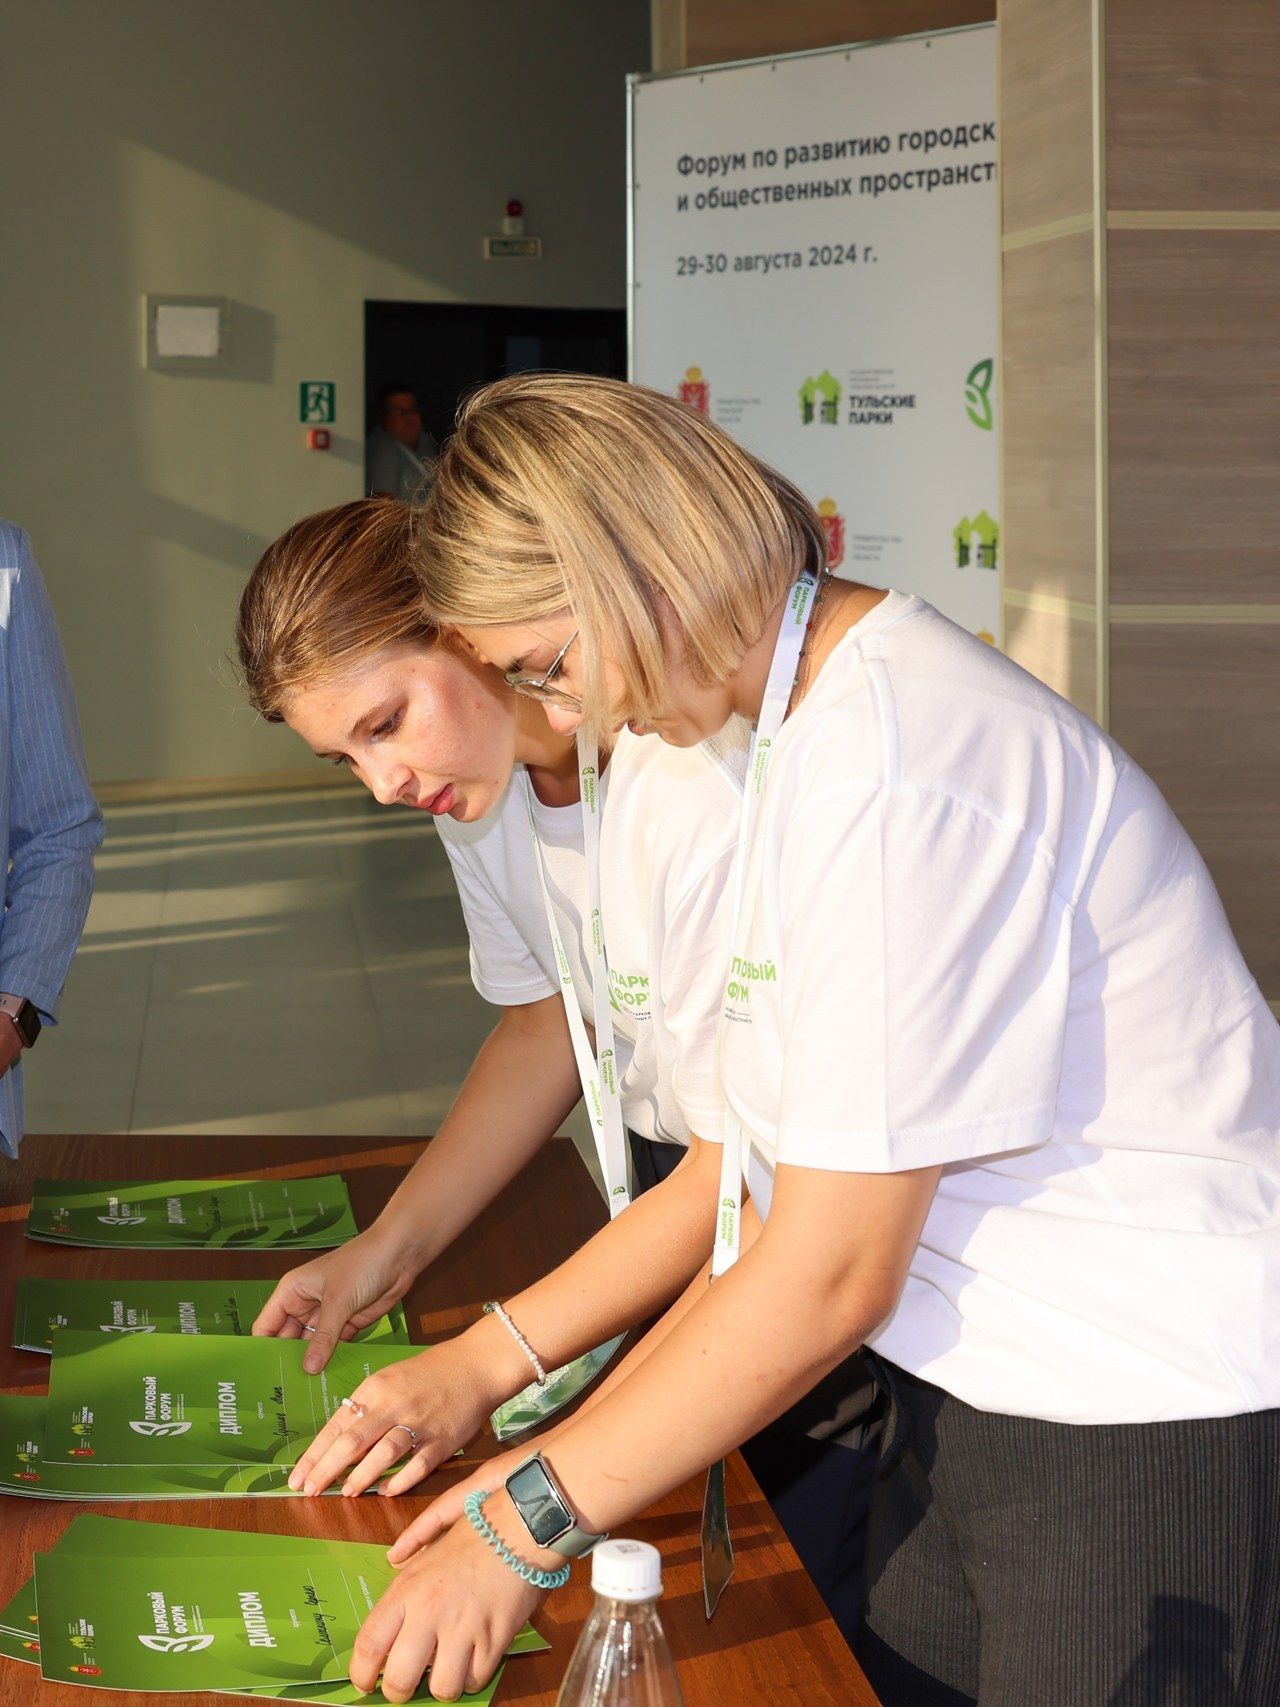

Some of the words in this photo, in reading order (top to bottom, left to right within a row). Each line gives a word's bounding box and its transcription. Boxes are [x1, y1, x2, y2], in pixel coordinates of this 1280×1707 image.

[677, 153, 746, 177] Форум
[753, 148, 778, 168] по
[785, 135, 891, 169] развитию
[898, 120, 996, 154] городск
[677, 196, 689, 212] и
[695, 176, 853, 212] общественных
[859, 161, 999, 196] пространст
[676, 254, 728, 276] 29-30
[733, 249, 803, 274] августа
[808, 243, 858, 268] 2024
[863, 248, 879, 263] г.
[848, 395, 917, 410] ТУЛЬСКИЕ
[848, 411, 894, 426] ПАРКИ
[791, 585, 803, 610] ФОРУМ
[795, 587, 810, 626] ПАРКОВЫЙ
[589, 778, 597, 814] ПАРКОВЫЙ
[614, 987, 650, 1006] ФОР
[608, 1059, 616, 1095] ПАРКОВЫЙ
[178, 1301, 202, 1335] ДИПЛОМ
[142, 1376, 157, 1421] ПАРКОВЫЙ
[160, 1393, 171, 1421] ФОРУМ
[218, 1381, 243, 1435] ДИПЛОМ
[147, 1591, 170, 1634] ПАРКОВЫЙ
[171, 1605, 189, 1634] ФОРУМ
[237, 1591, 278, 1648] ДИПЛОМ
